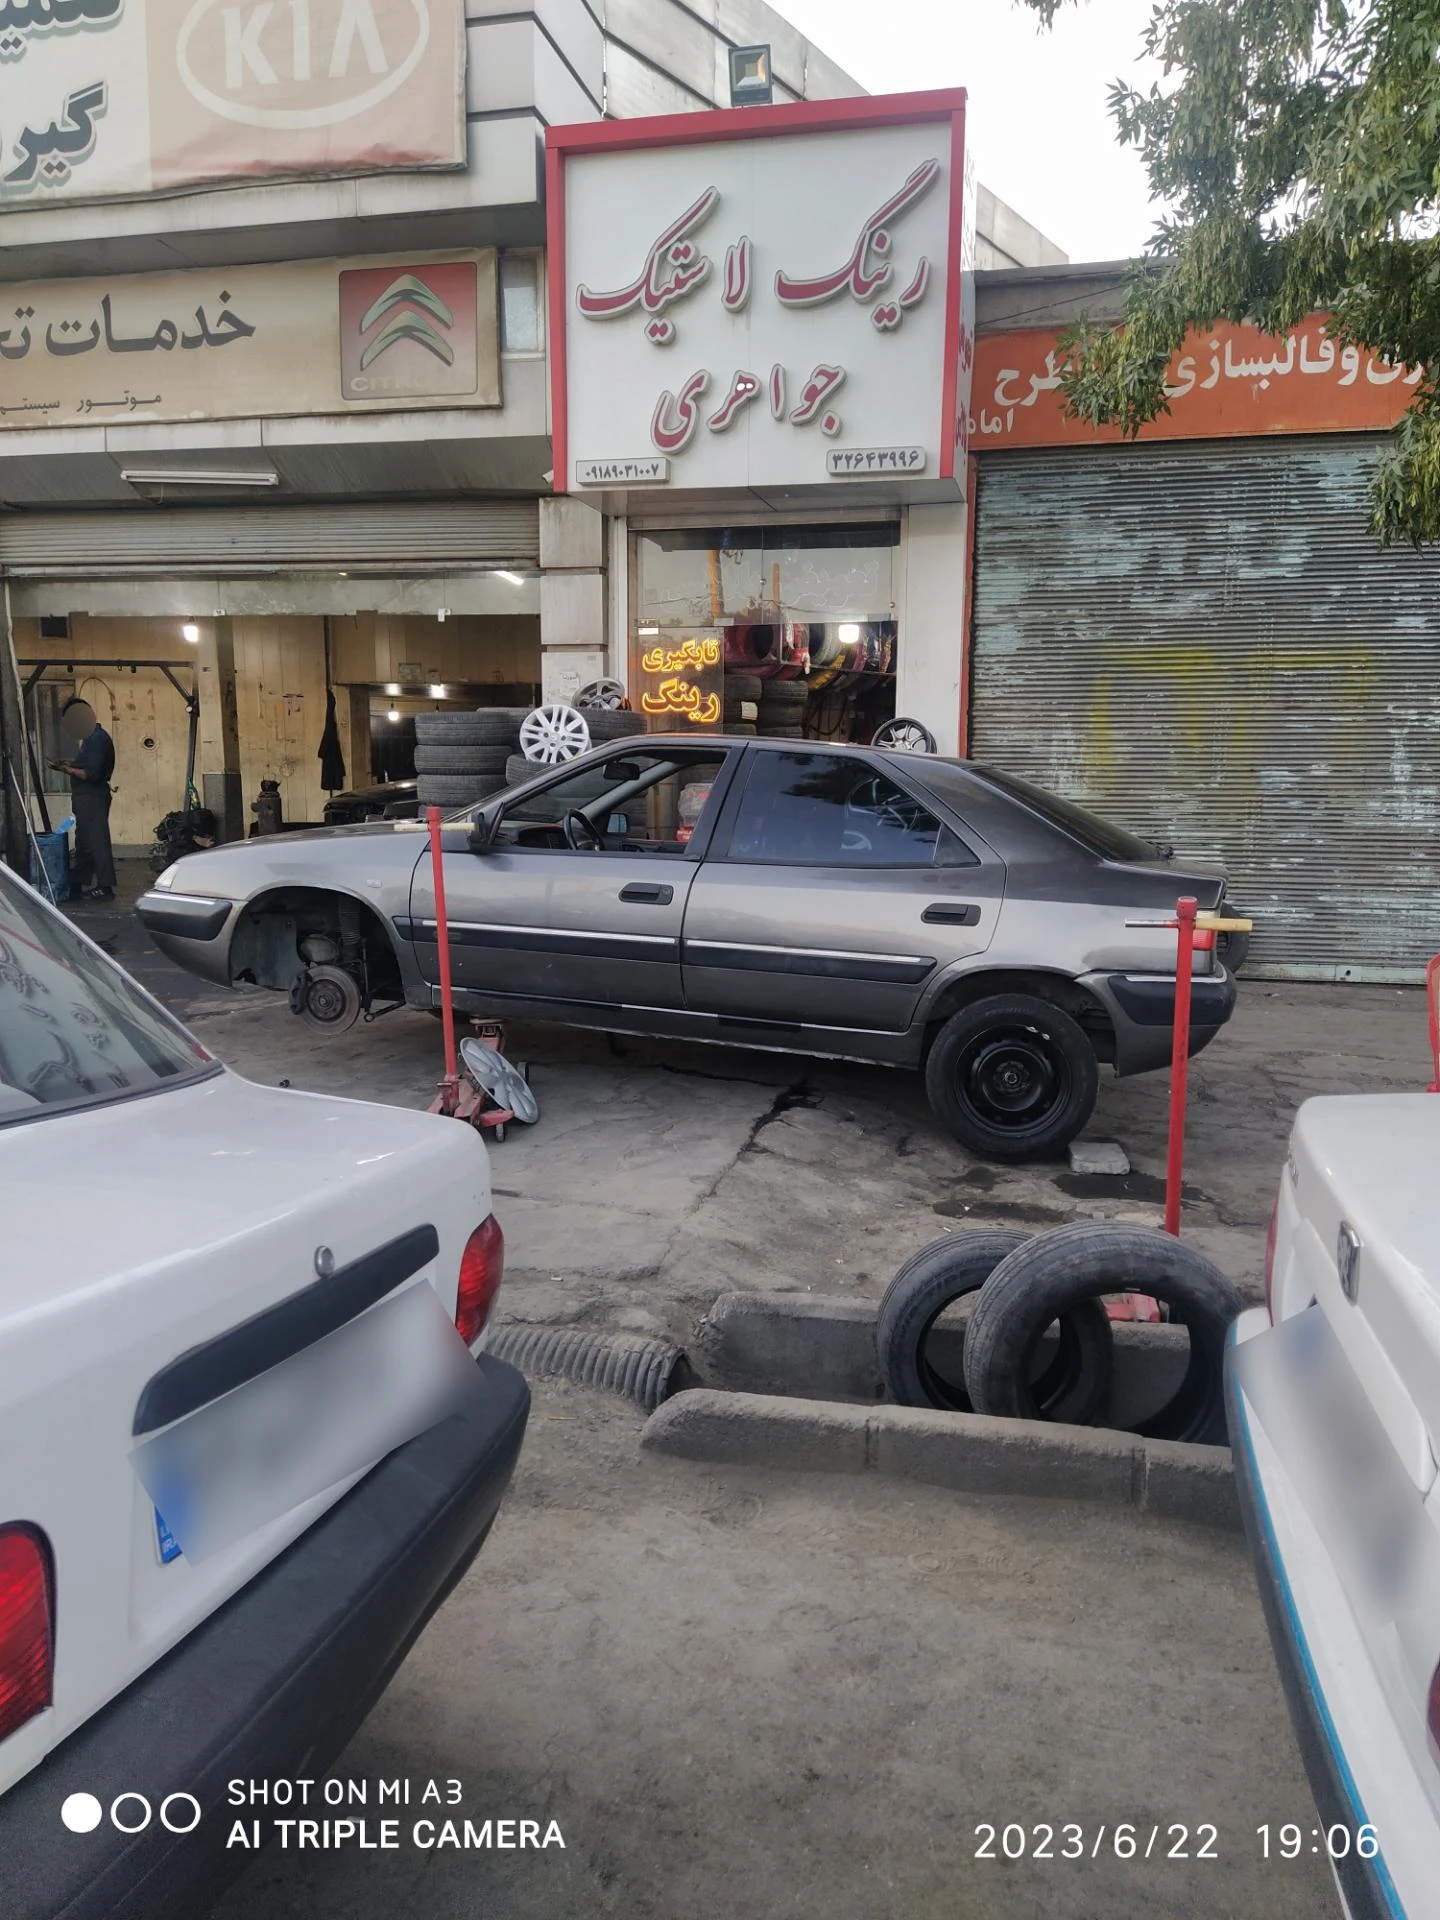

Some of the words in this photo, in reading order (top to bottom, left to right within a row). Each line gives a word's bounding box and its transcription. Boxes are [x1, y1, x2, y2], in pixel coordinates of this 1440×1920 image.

[219, 0, 389, 89] KIA
[576, 185, 752, 345] لاستیک
[774, 158, 940, 332] رینگ
[45, 290, 256, 356] خدمات
[76, 390, 162, 414] موتور
[650, 364, 847, 454] جواهری
[641, 677, 721, 722] رینگ
